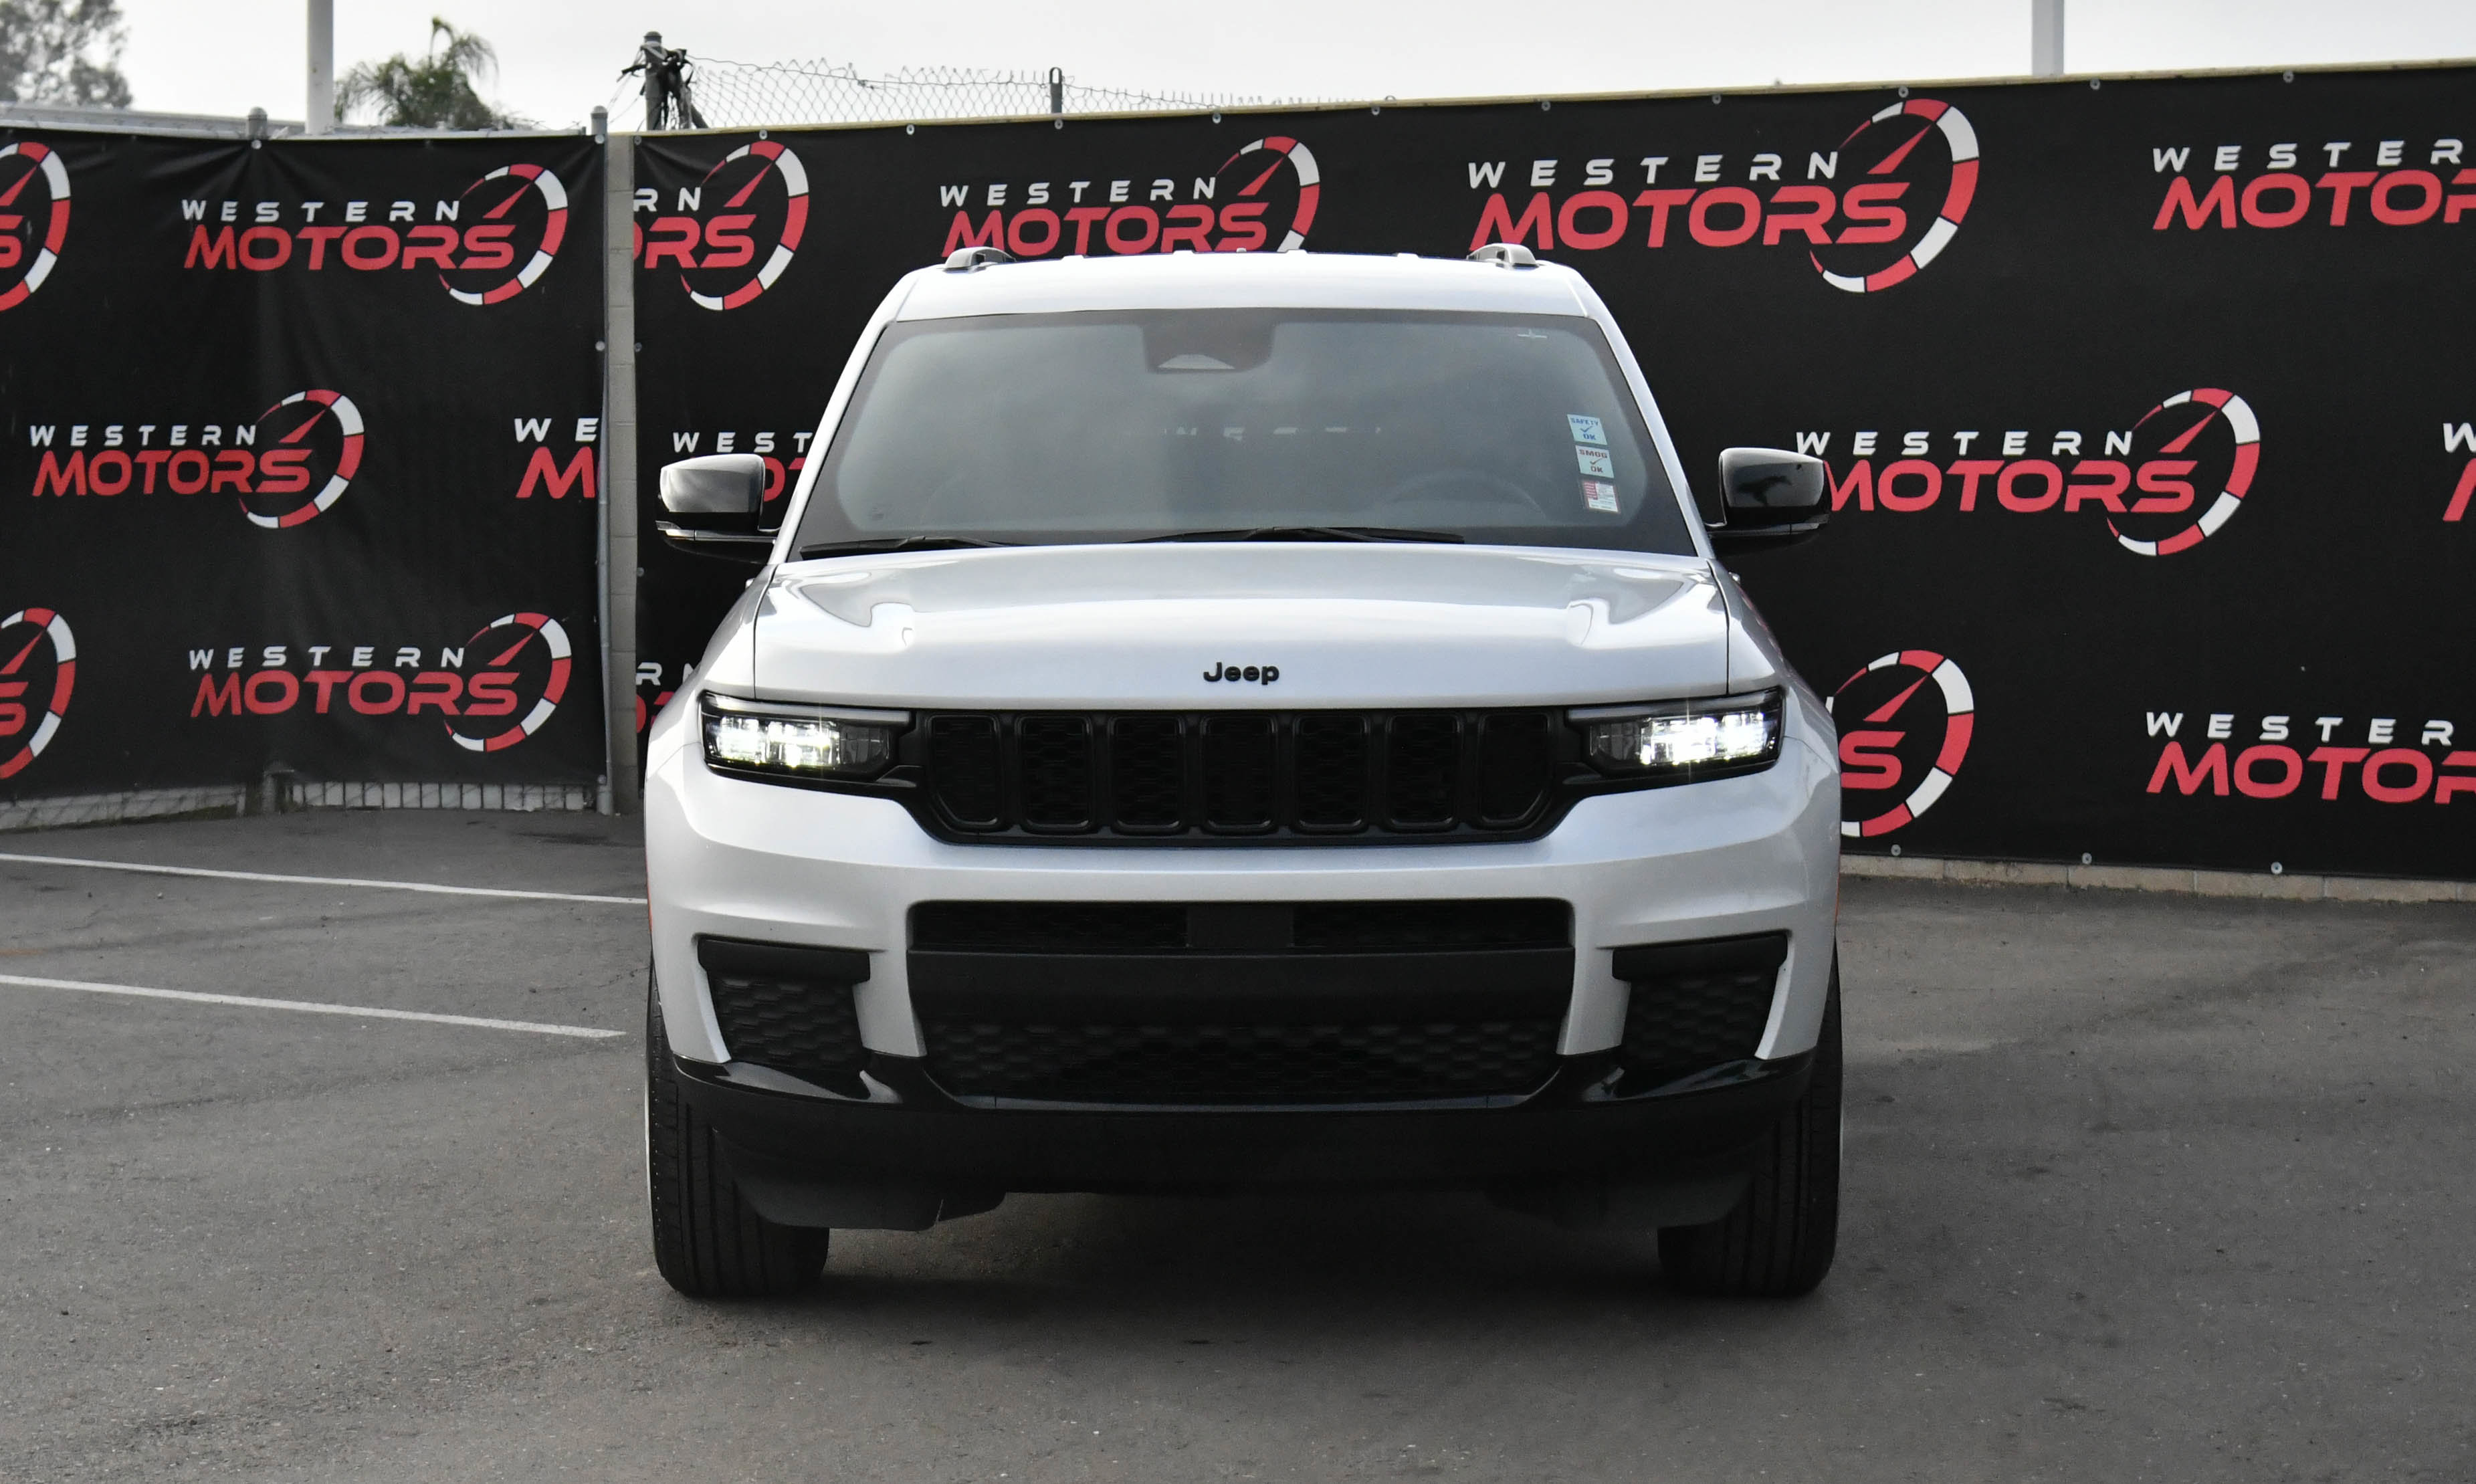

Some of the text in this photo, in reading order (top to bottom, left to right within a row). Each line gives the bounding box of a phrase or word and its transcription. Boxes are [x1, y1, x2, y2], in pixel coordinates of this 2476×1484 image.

[1468, 151, 1839, 189] WESTERN
[2152, 138, 2464, 173] WESTER
[940, 177, 1216, 207] WESTERN
[2153, 169, 2476, 231] MOTO
[182, 199, 459, 223] WESTERN
[1469, 182, 1910, 252] MOTORS
[942, 202, 1269, 257] MOTORS
[185, 224, 516, 271] MOTORS
[30, 425, 256, 447] WESTERN
[1570, 417, 1599, 426] SAFETY
[673, 432, 813, 453] WEST
[1579, 449, 1608, 458] SMOG
[1796, 431, 2133, 456] WESTERN
[32, 449, 312, 497] MOTORS
[189, 646, 465, 671] WESTERN
[1203, 662, 1279, 685] Jeep
[191, 669, 520, 718] MOTORS
[2146, 712, 2454, 746] WESTER
[2146, 741, 2476, 805] MOTOR
